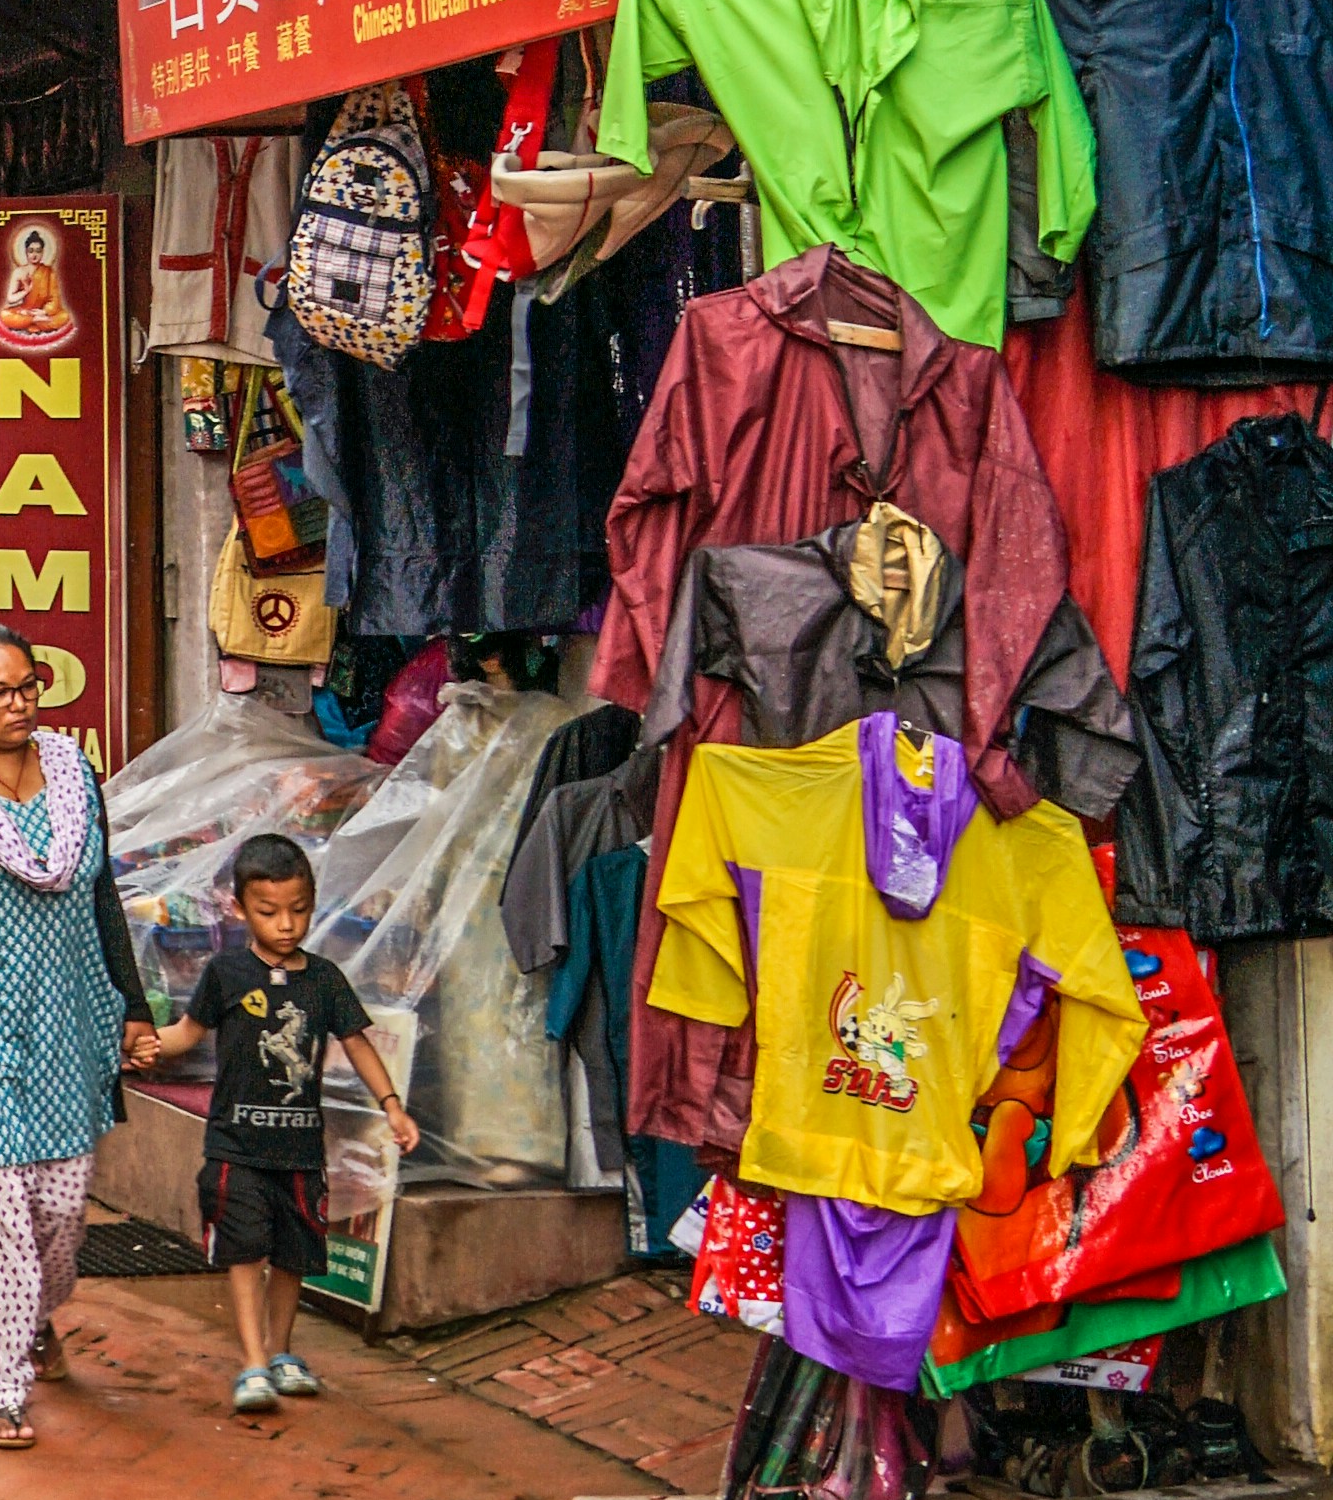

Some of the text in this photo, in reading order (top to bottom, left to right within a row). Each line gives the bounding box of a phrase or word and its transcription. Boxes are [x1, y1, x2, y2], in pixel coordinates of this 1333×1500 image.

[276, 14, 312, 62] 藏餐
[353, 0, 402, 43] Chinese
[1136, 981, 1171, 1002] loud
